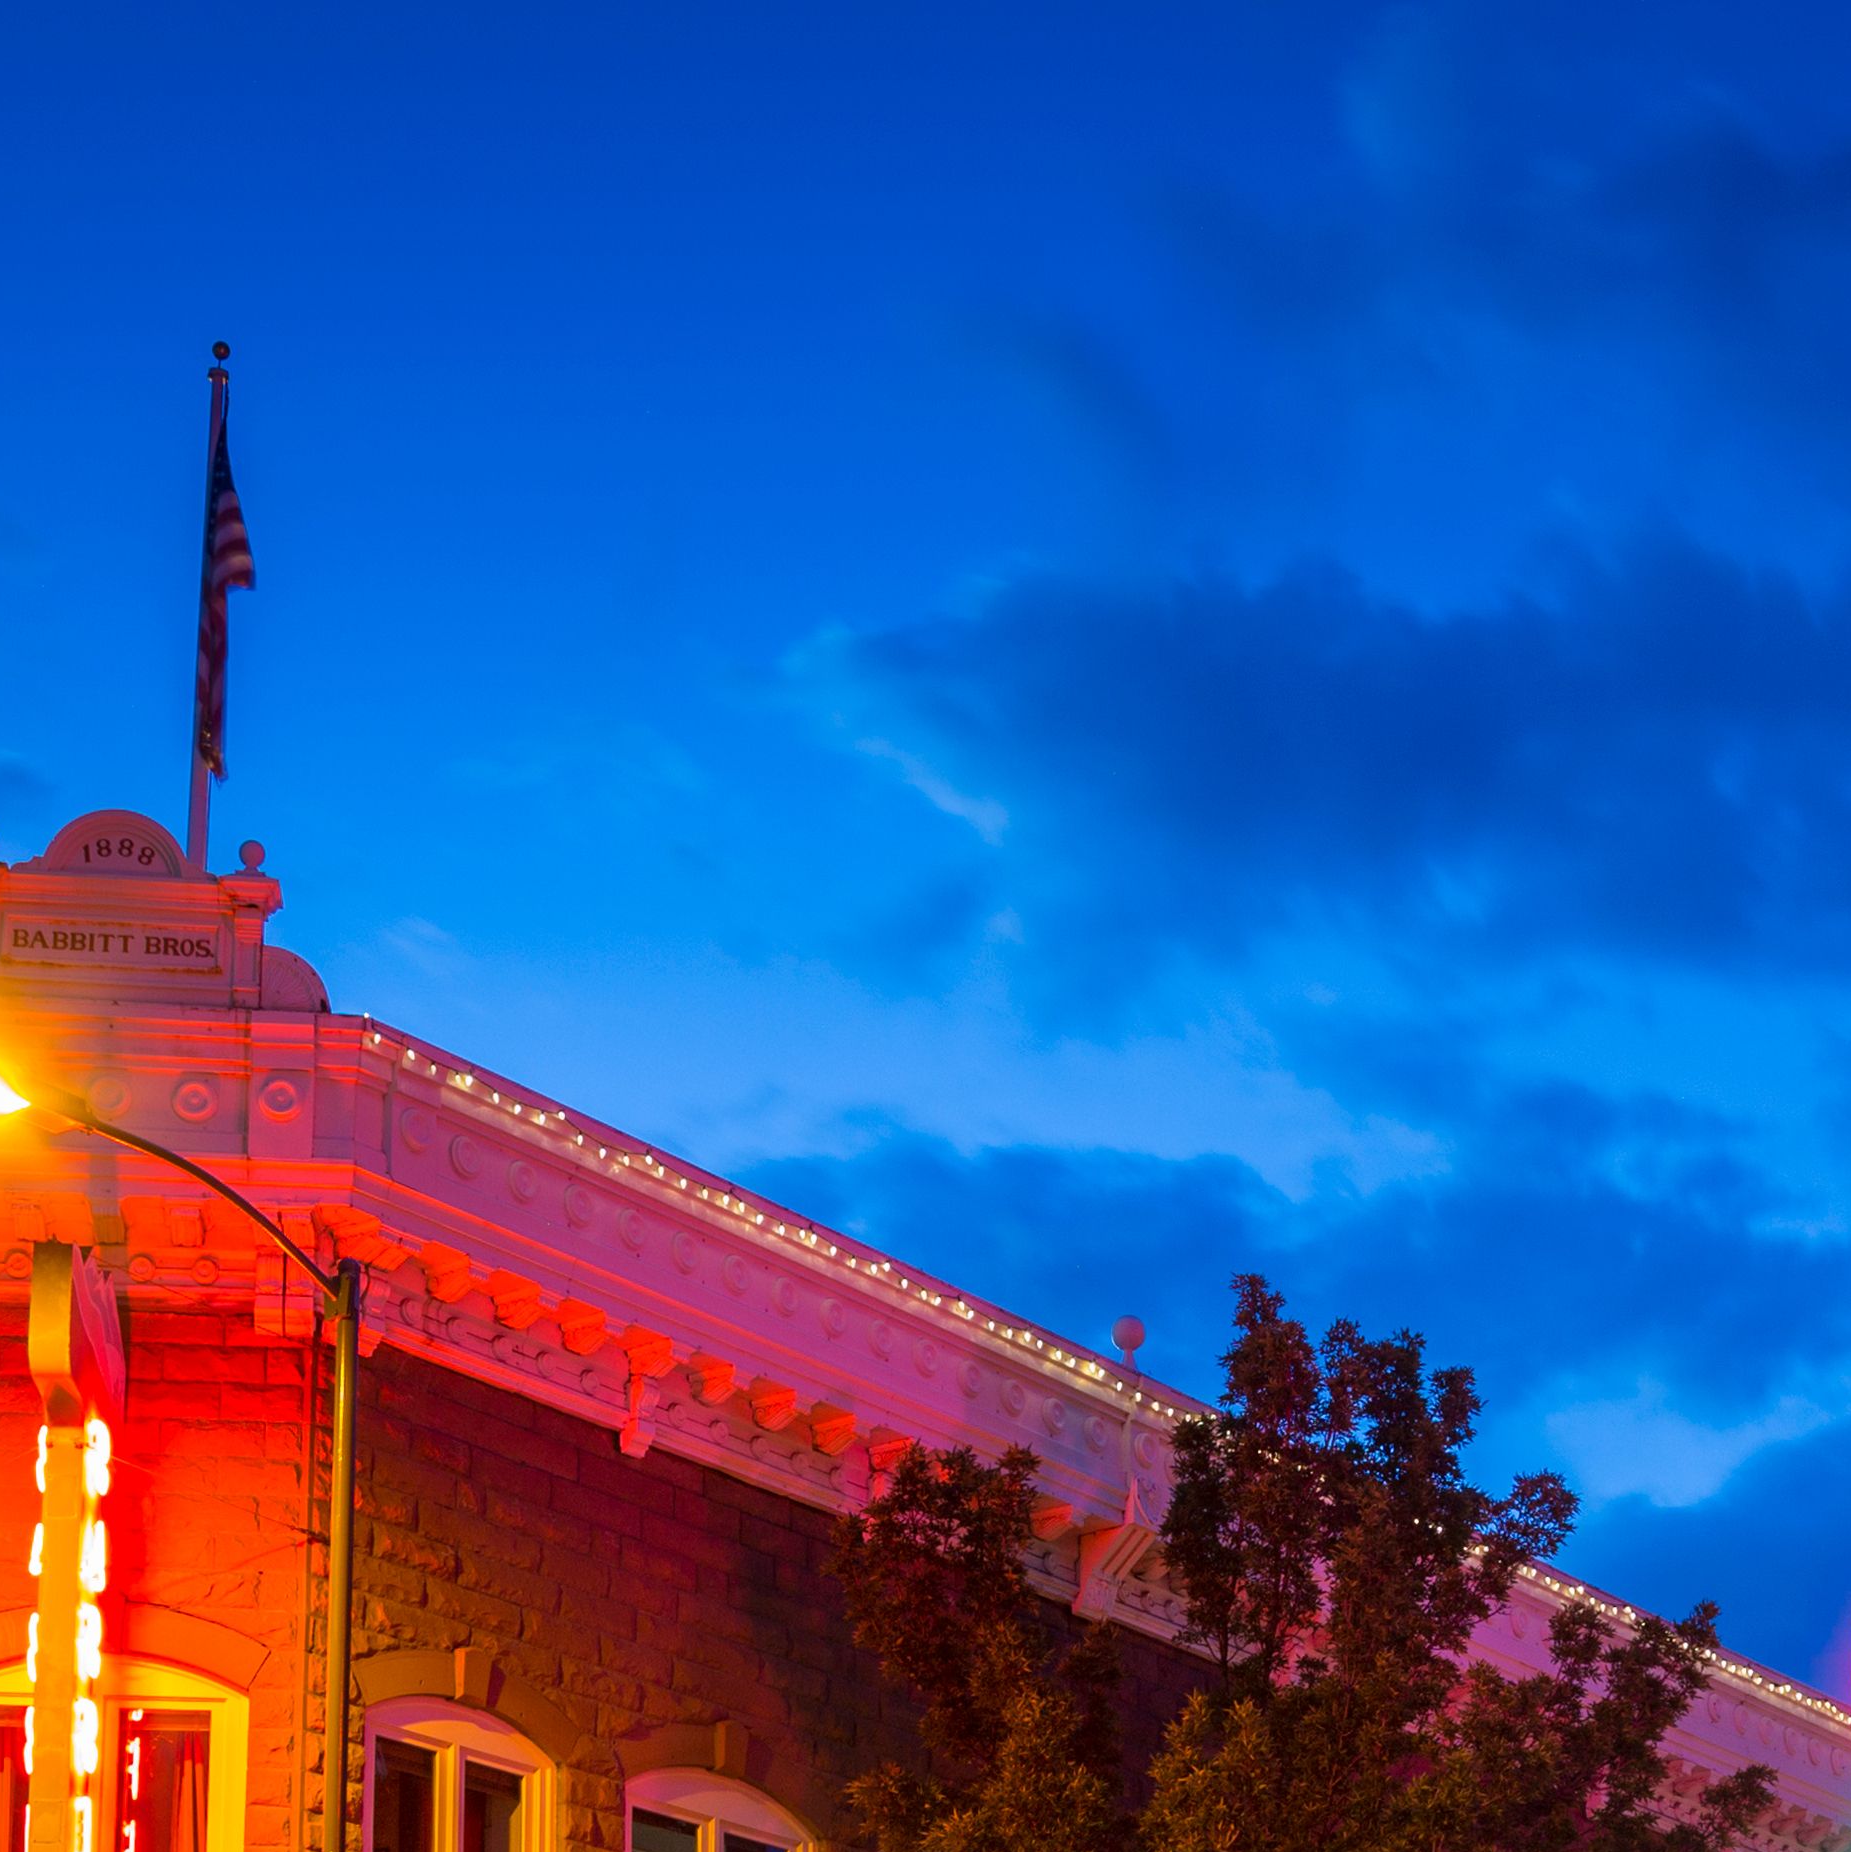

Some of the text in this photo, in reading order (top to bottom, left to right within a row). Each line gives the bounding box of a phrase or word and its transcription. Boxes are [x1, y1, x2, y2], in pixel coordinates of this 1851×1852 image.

[82, 838, 156, 866] 1888
[12, 928, 215, 958] BABBITT BROS.
